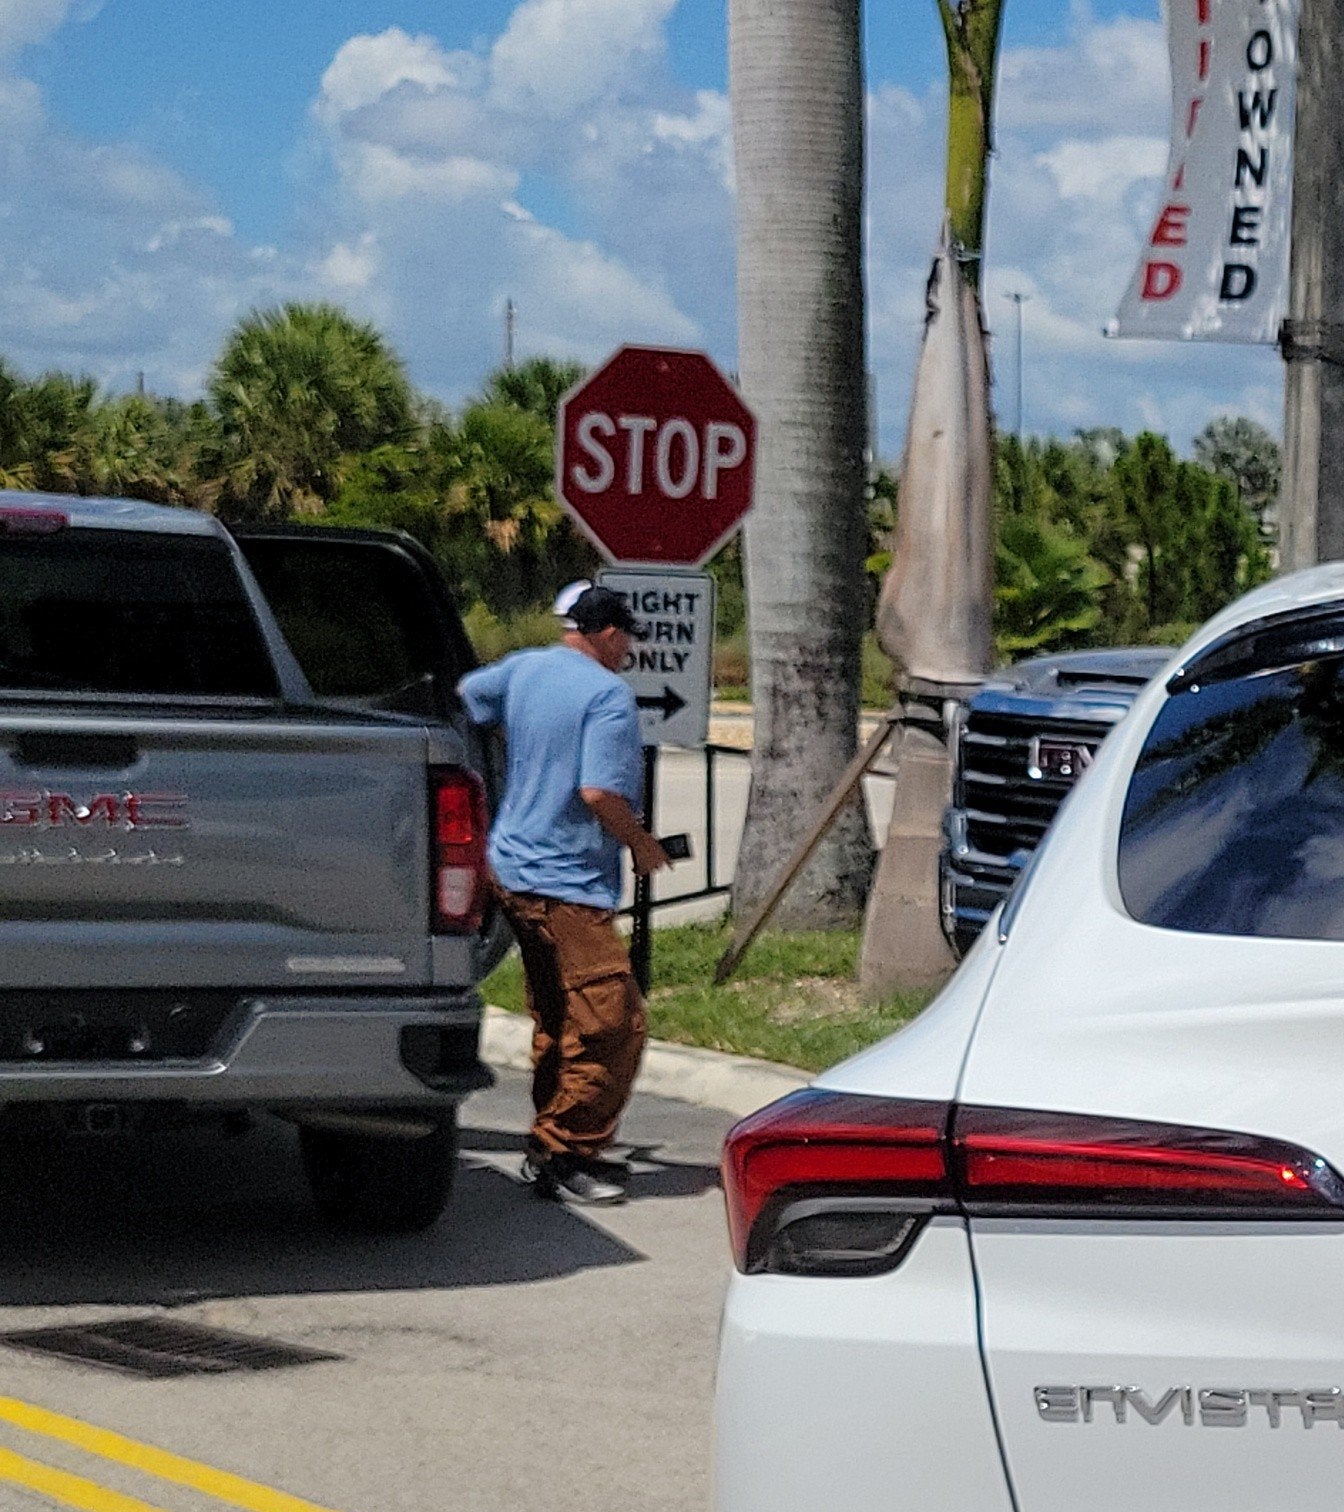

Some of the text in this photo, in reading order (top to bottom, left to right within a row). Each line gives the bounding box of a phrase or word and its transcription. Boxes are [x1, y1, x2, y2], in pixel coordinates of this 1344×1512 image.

[1219, 29, 1278, 302] OWNED
[572, 410, 747, 500] STOP
[624, 590, 700, 615] IGHT
